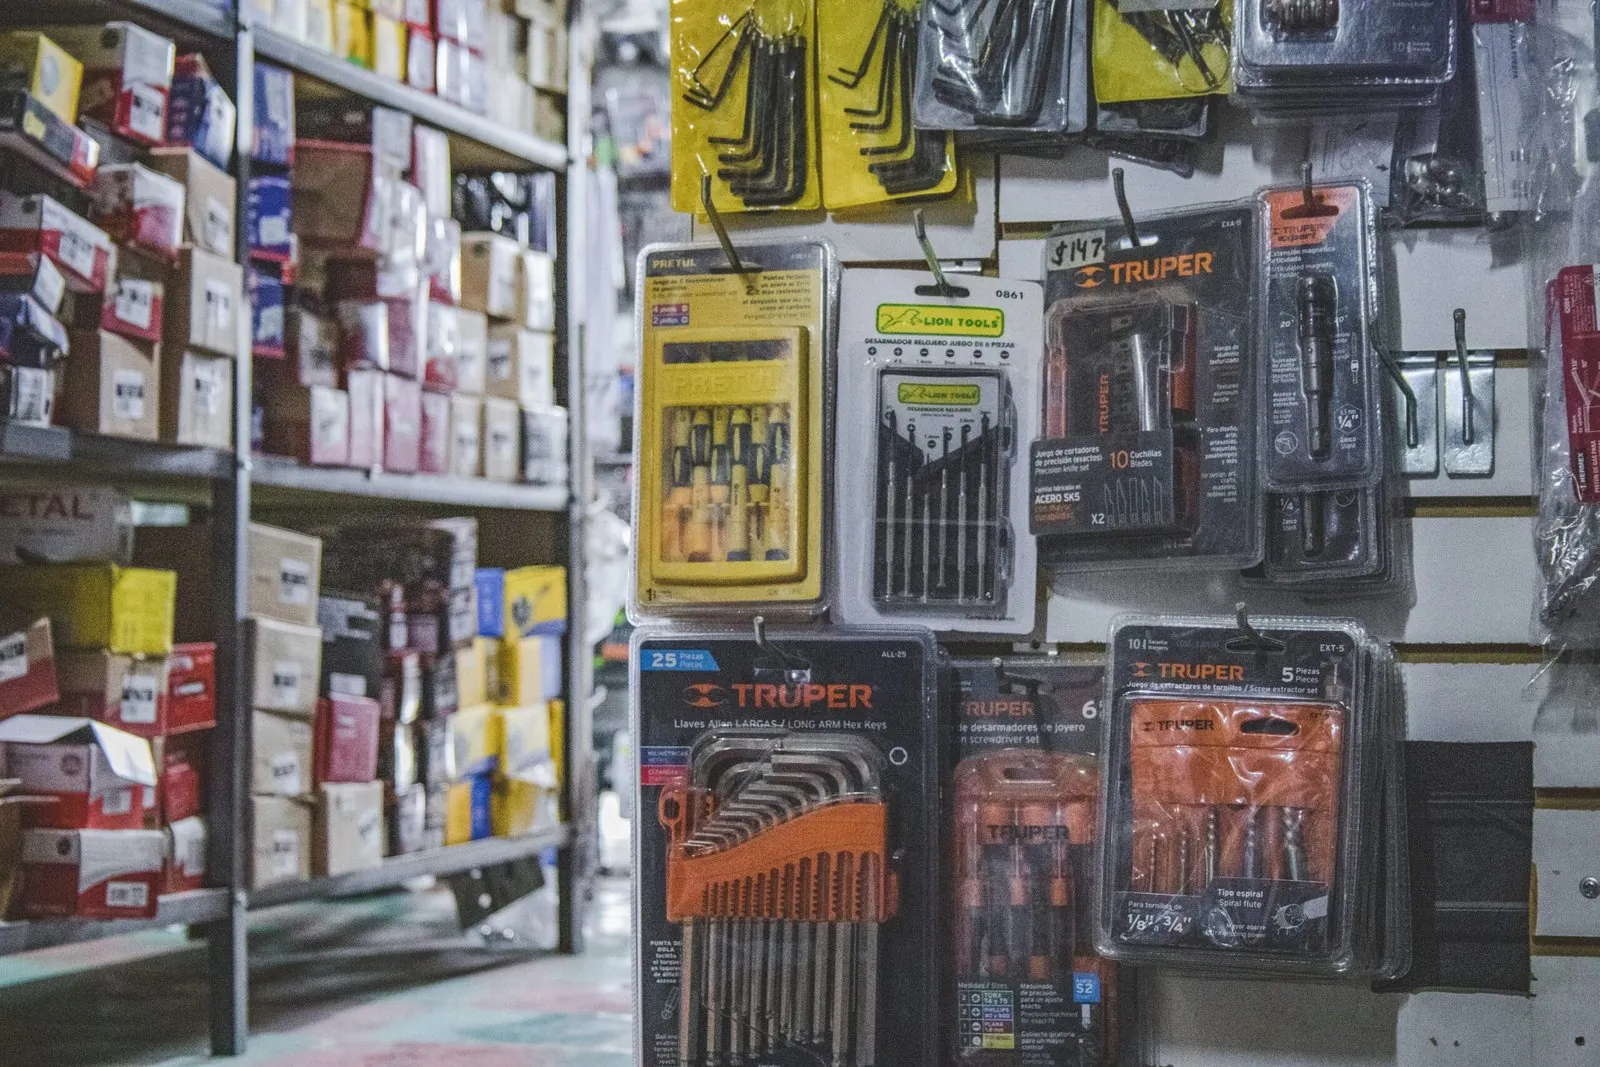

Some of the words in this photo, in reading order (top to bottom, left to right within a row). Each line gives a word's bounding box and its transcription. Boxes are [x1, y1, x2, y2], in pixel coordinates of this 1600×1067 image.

[1283, 223, 1325, 234] TRUPER
[1278, 232, 1316, 242] expert
[1051, 237, 1103, 267] $147
[652, 258, 697, 269] PRETUL
[1109, 252, 1214, 285] TRUPER
[995, 289, 1024, 300] 0861
[923, 317, 953, 327] LION
[958, 318, 998, 329] TOOLS
[864, 337, 912, 345] DESARMADOR
[1099, 374, 1109, 432] TRUPER
[1035, 449, 1054, 458] Juego
[1064, 446, 1100, 455] cortadores
[1130, 449, 1163, 459] Cuchillas
[1043, 456, 1073, 466] precisión
[1073, 453, 1103, 462] (exactos)
[1110, 450, 1129, 470] 10
[1130, 459, 1153, 467] Blades
[1591, 455, 1599, 466] GAS
[1034, 465, 1061, 476] Precision
[1063, 464, 1079, 473] knife
[1578, 452, 1586, 484] HERMEX
[1034, 493, 1062, 505] ACERO
[1063, 492, 1081, 502] SK5
[1091, 513, 1105, 525] X2
[1128, 638, 1141, 650] 10
[1320, 644, 1345, 653] EXT-5
[881, 650, 907, 658] ALL-25
[651, 653, 678, 668] 25
[679, 653, 705, 661] Piezas
[1157, 663, 1245, 681] TRUPER
[1281, 667, 1294, 683] 5
[1295, 667, 1320, 675] Piezas
[1295, 675, 1319, 683] Pieces
[1127, 681, 1149, 689] Juego
[1149, 682, 1160, 690] de
[1160, 682, 1201, 691] extractores
[1212, 684, 1242, 692] tornillos
[1250, 684, 1271, 692] Screw
[1272, 685, 1305, 693] extractor
[731, 683, 873, 709] TRUPER
[961, 700, 1035, 717] RUPER
[1081, 700, 1097, 719] 6
[674, 719, 705, 729] Llaves
[708, 719, 734, 729] Allen
[735, 719, 778, 729] LARGAS
[787, 719, 816, 729] LONG
[818, 720, 841, 729] ARM
[843, 720, 862, 729] Hex
[864, 720, 888, 731] Keys
[970, 722, 1038, 732] desarmadores
[1054, 723, 1085, 734] joyero
[1158, 719, 1215, 731] TRUPER
[969, 734, 1022, 744] screwdriver
[1025, 735, 1040, 744] set
[1218, 889, 1234, 898] Tipo
[1236, 889, 1264, 899] espiral
[1128, 900, 1144, 908] Para
[1219, 899, 1242, 909] Spiral
[1243, 900, 1262, 908] flute
[1075, 984, 1093, 995] S2
[1048, 1031, 1075, 1039] giratoria
